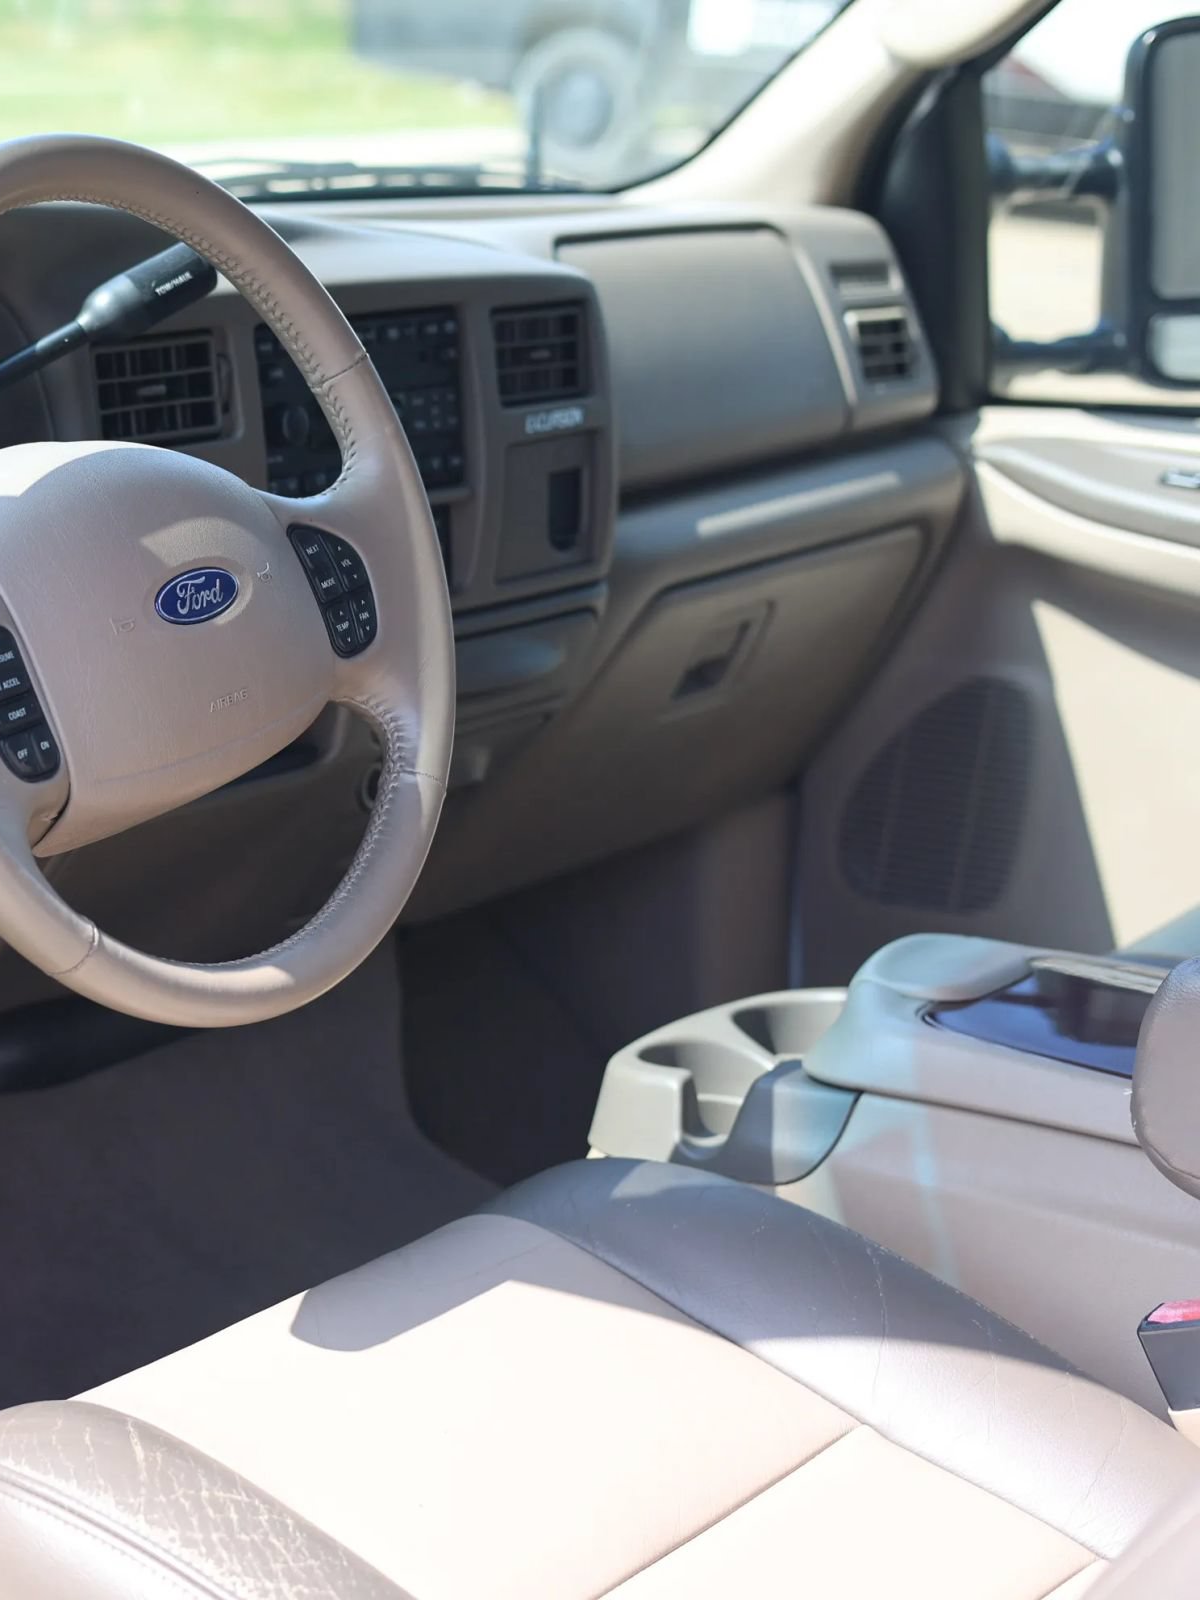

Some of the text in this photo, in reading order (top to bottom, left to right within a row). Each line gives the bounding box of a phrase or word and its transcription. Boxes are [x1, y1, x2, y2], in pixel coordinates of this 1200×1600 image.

[305, 544, 319, 555] NEXT
[341, 558, 352, 568] VOL
[320, 577, 336, 589] MODE
[176, 576, 224, 615] Ford
[358, 610, 370, 622] FAN
[335, 620, 350, 632] TEMP
[2, 677, 21, 691] ACCEL
[209, 688, 248, 713] AIRBAG
[7, 707, 27, 721] COAST
[40, 740, 50, 751] ON
[17, 748, 29, 760] OFF
